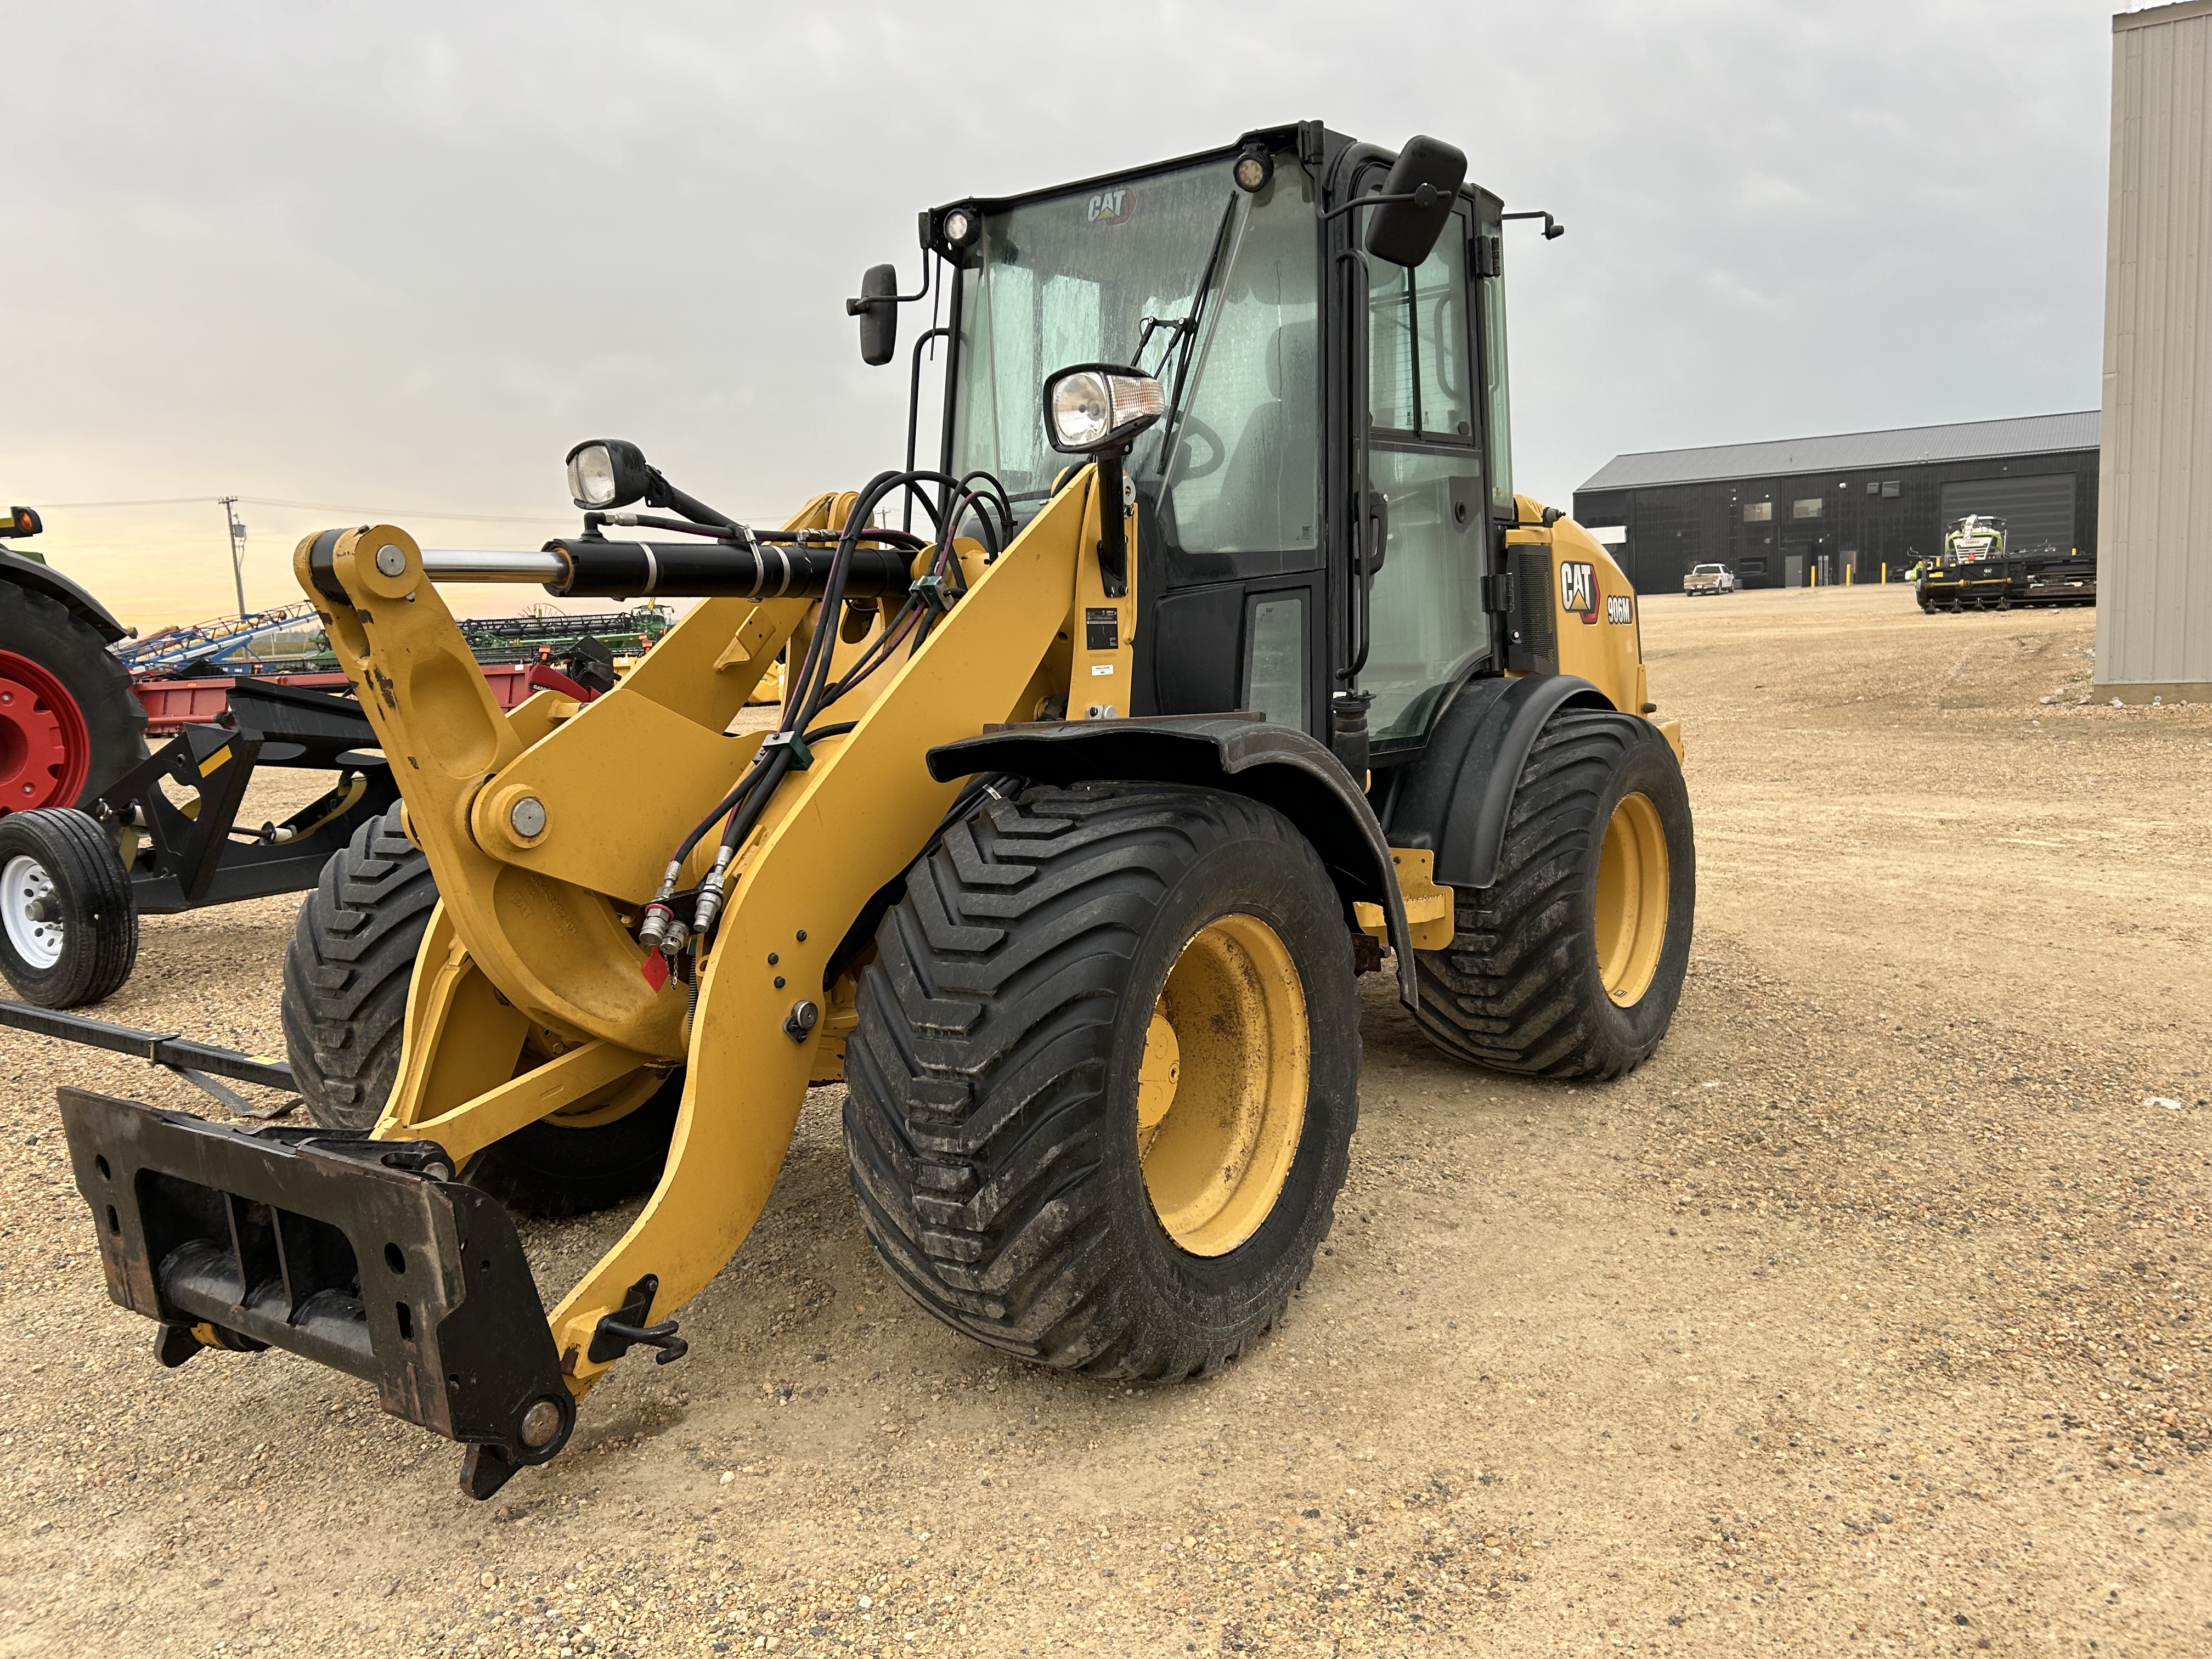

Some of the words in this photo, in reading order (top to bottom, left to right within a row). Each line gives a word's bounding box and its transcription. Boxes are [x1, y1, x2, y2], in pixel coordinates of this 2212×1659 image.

[1088, 189, 1126, 222] CAT
[1561, 563, 1590, 610] CAT
[1607, 596, 1630, 623] 906M
